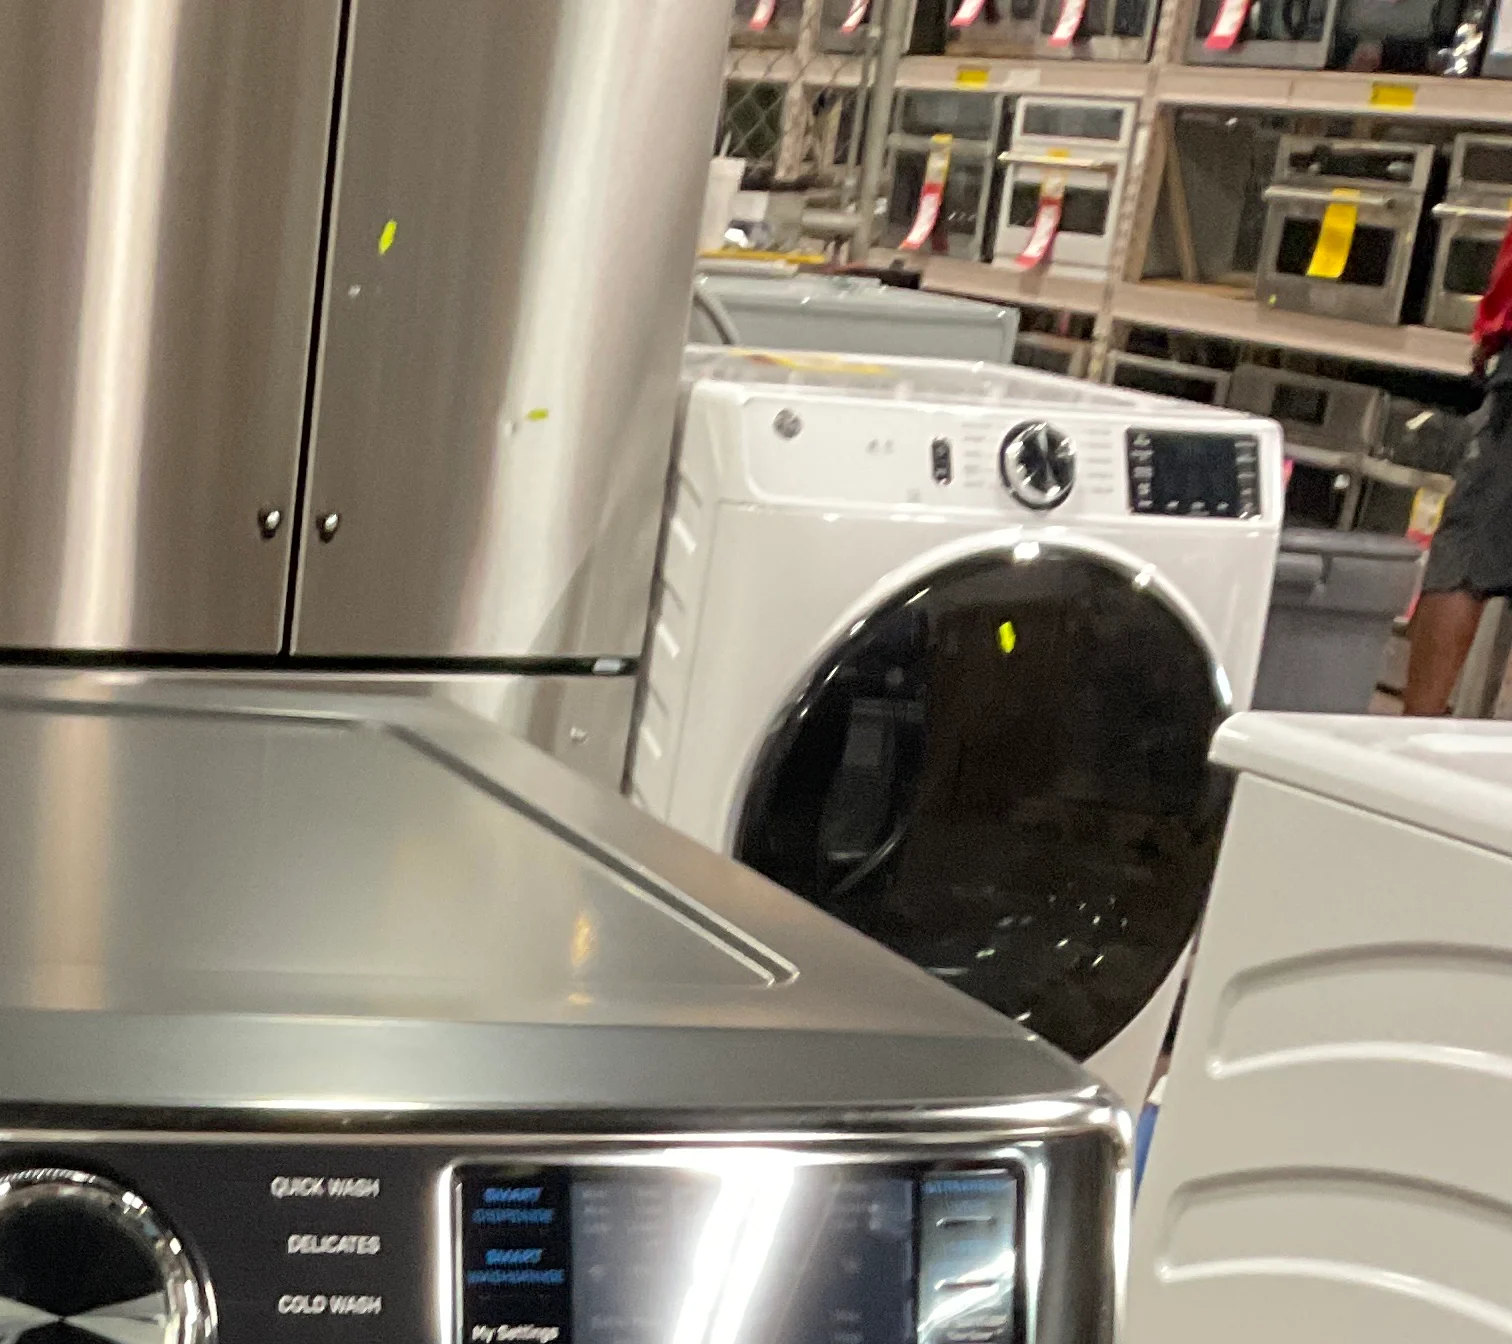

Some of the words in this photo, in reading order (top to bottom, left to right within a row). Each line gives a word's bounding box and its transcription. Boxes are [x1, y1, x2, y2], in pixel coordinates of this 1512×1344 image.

[270, 1176, 325, 1199] QUICK
[327, 1176, 381, 1198] WASH
[288, 1234, 381, 1255] DELICATES
[277, 1294, 328, 1315] COLD
[329, 1294, 383, 1314] WASH
